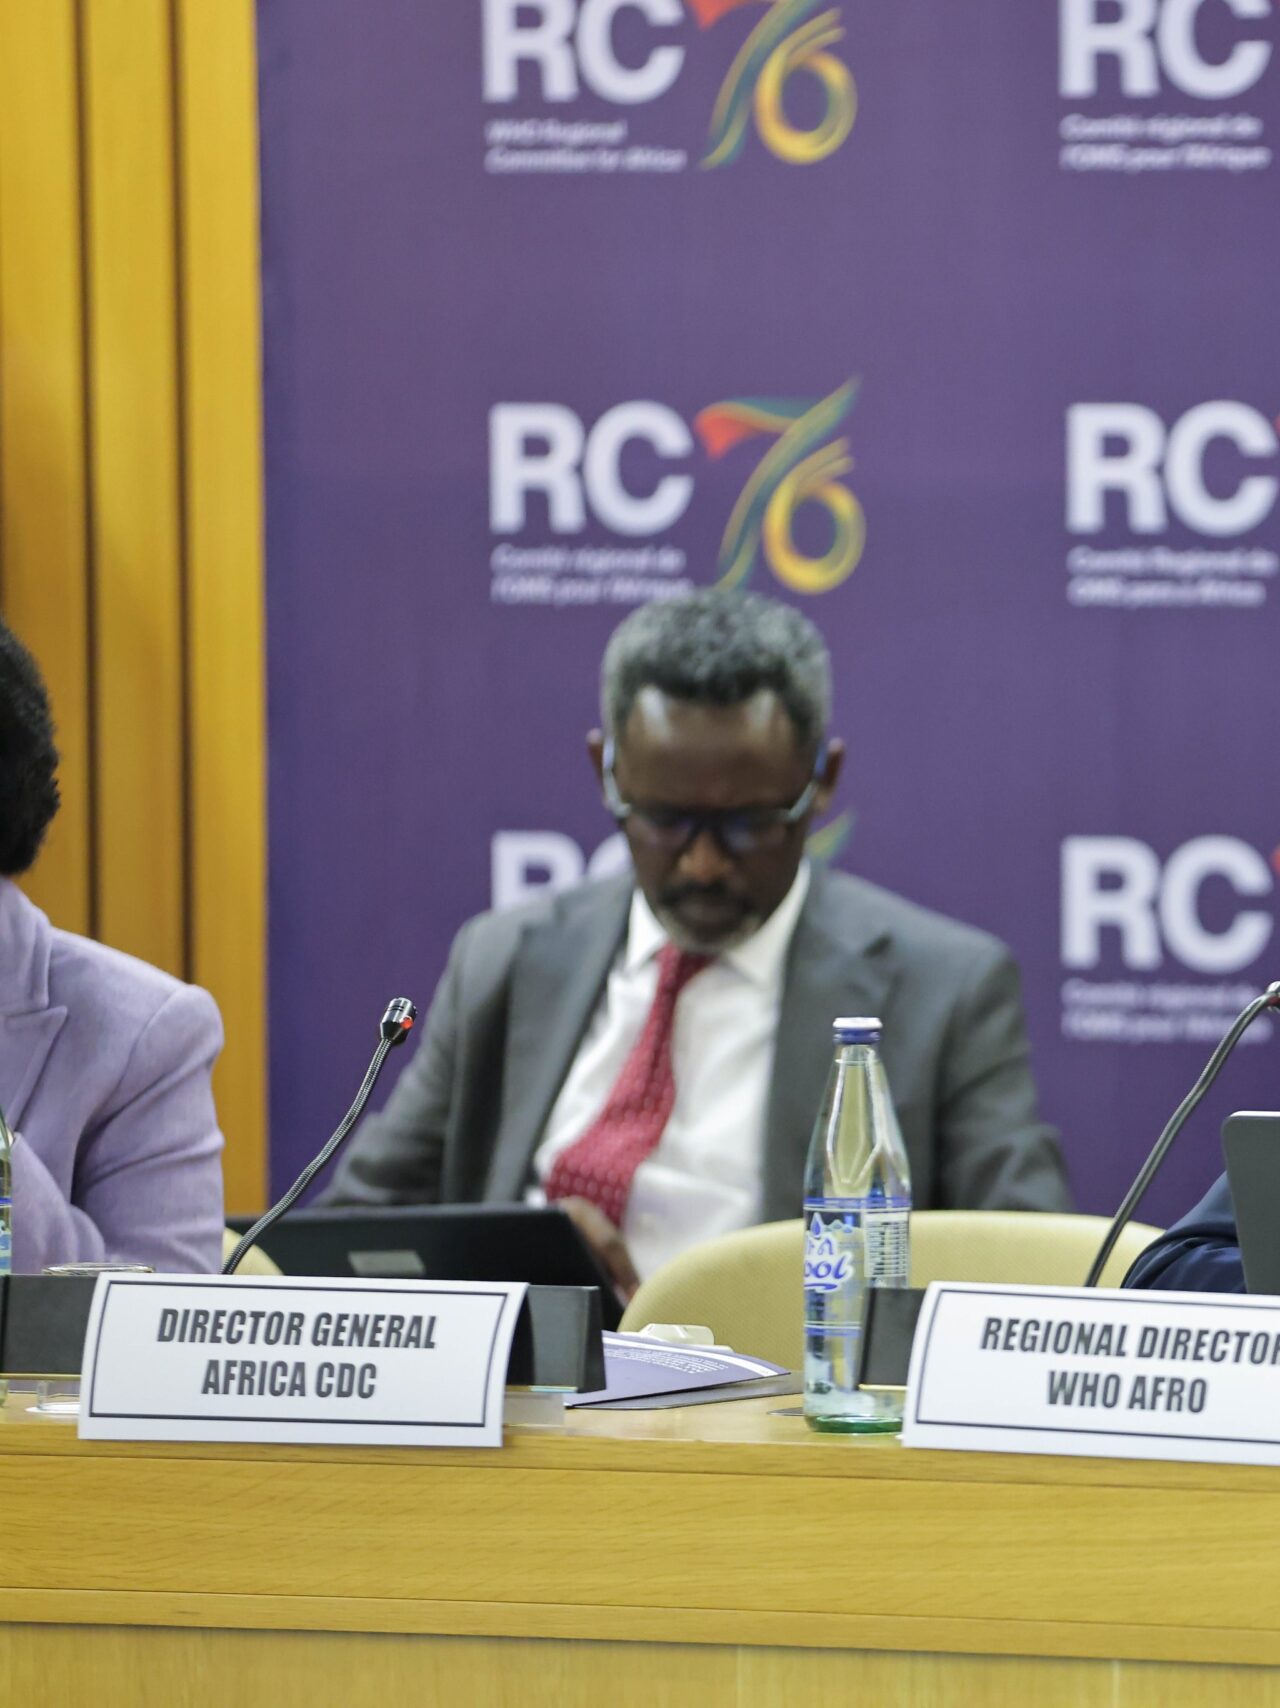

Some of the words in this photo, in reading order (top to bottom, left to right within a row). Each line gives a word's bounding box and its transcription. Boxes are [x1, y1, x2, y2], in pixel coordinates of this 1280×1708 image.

[157, 1308, 305, 1346] DIRECTOR
[312, 1311, 437, 1350] GENERAL
[981, 1317, 1129, 1358] REGIONAL
[201, 1359, 306, 1397] AFRICA
[315, 1362, 377, 1400] CDC
[1047, 1369, 1121, 1409] WHO
[1129, 1374, 1207, 1414] AFRO
